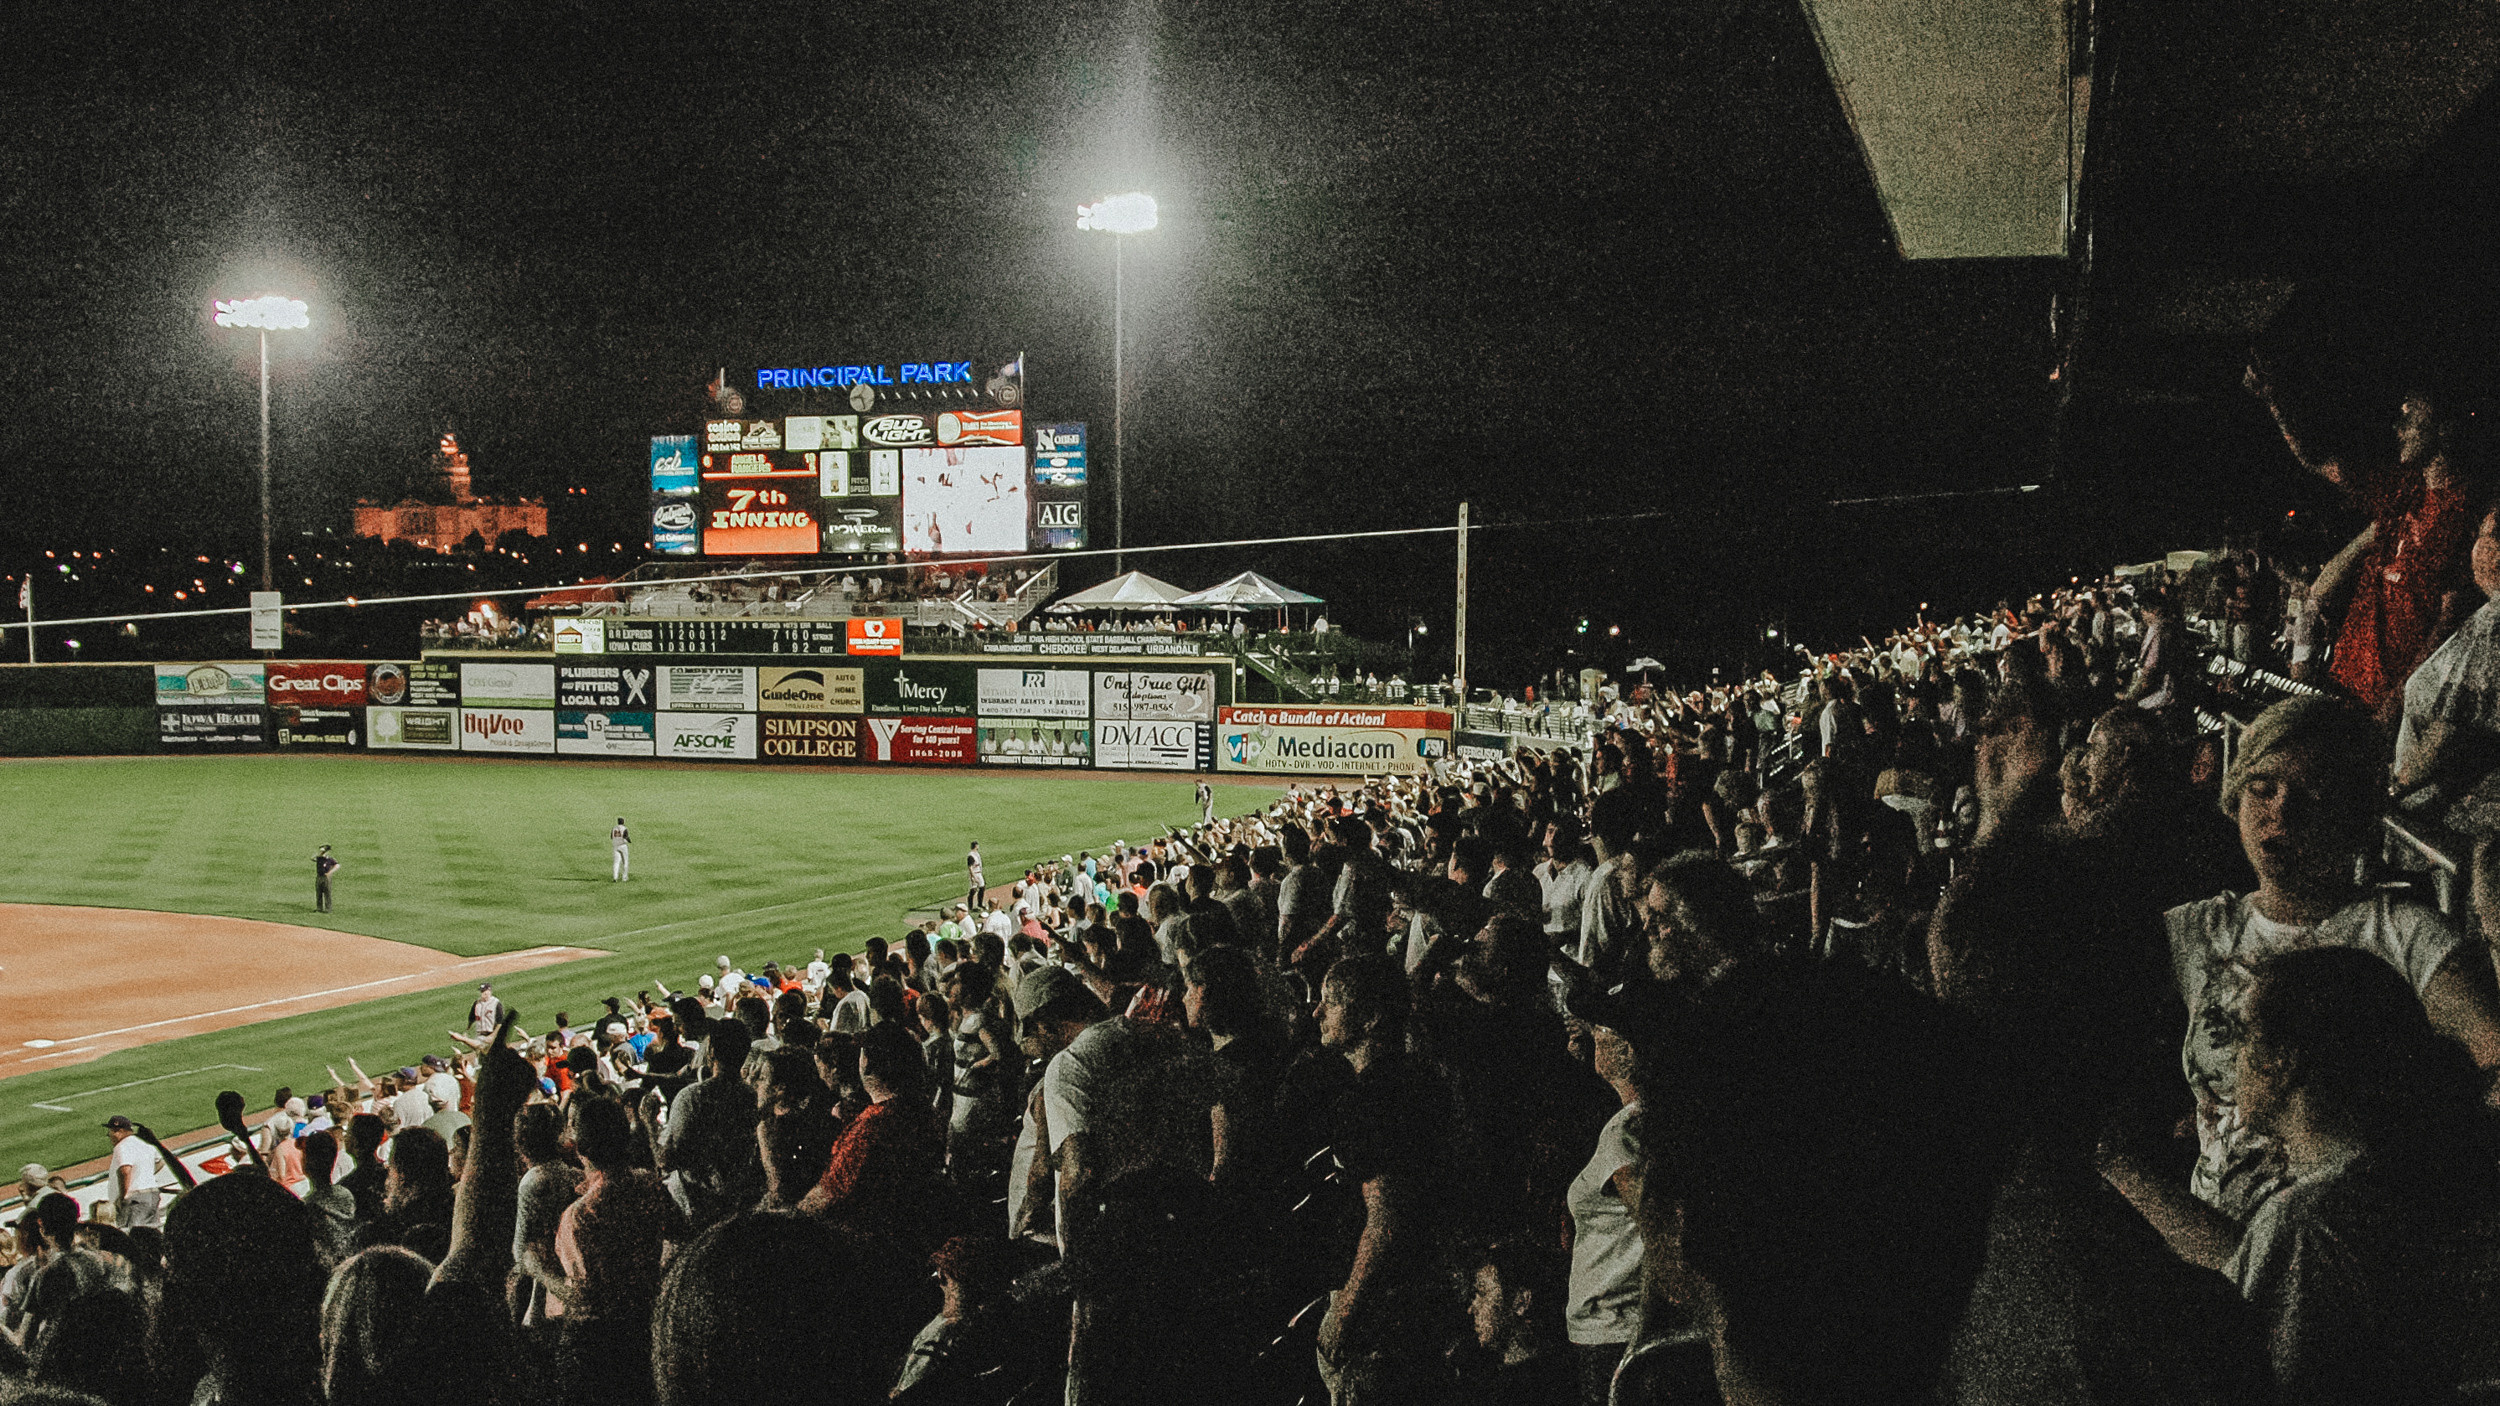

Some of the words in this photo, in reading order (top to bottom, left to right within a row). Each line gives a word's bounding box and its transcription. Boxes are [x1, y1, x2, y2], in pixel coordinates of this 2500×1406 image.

[758, 365, 894, 389] PRINCIPAL
[902, 361, 973, 384] PARK
[878, 419, 923, 431] BUD
[870, 429, 931, 442] LIGHT
[727, 489, 788, 511] 7th
[712, 511, 811, 529] INNING
[1040, 503, 1079, 525] AIG
[623, 629, 653, 639] EXPRESS
[1060, 635, 1085, 644] SCHOOL
[1105, 635, 1136, 644] BASEBALL
[1039, 644, 1087, 654] CHEROKEE
[1146, 644, 1198, 655] URBANDALE
[561, 667, 620, 678] PLUMBERS
[269, 674, 320, 691] Great
[323, 674, 363, 695] Clips
[574, 681, 619, 692] FITTERS
[834, 686, 856, 694] HOME
[1104, 675, 1132, 690] One
[1137, 678, 1172, 690] True
[1176, 675, 1206, 696] Gift
[561, 695, 597, 706] LOCAL
[600, 695, 620, 706] #33
[761, 688, 825, 701] GuideOne
[904, 683, 948, 705] Mercy
[830, 698, 861, 706] CHURCH
[1056, 698, 1086, 706] BROKERS
[182, 713, 214, 725] IOWA
[216, 713, 261, 725] HEALTH
[1232, 710, 1267, 724] Catch
[1268, 714, 1278, 723] a
[1279, 710, 1323, 724] Bundle
[1324, 711, 1340, 725] of
[1340, 712, 1387, 726] Action!
[464, 713, 524, 739] HyVee
[765, 718, 857, 738] SIMPSON
[900, 724, 927, 735] Serving
[928, 725, 954, 734] Central
[954, 725, 973, 734] Iowa
[673, 733, 737, 749] AFSCME
[912, 735, 923, 743] for
[1100, 725, 1193, 747] DMACC
[764, 738, 857, 758] COLLEGE
[1228, 737, 1262, 762] vip
[1277, 735, 1395, 759] Mediacom
[1294, 760, 1310, 769] DVR
[1317, 760, 1335, 769] VOD
[1341, 761, 1380, 770] INTERNET
[1387, 762, 1415, 771] PHONE
